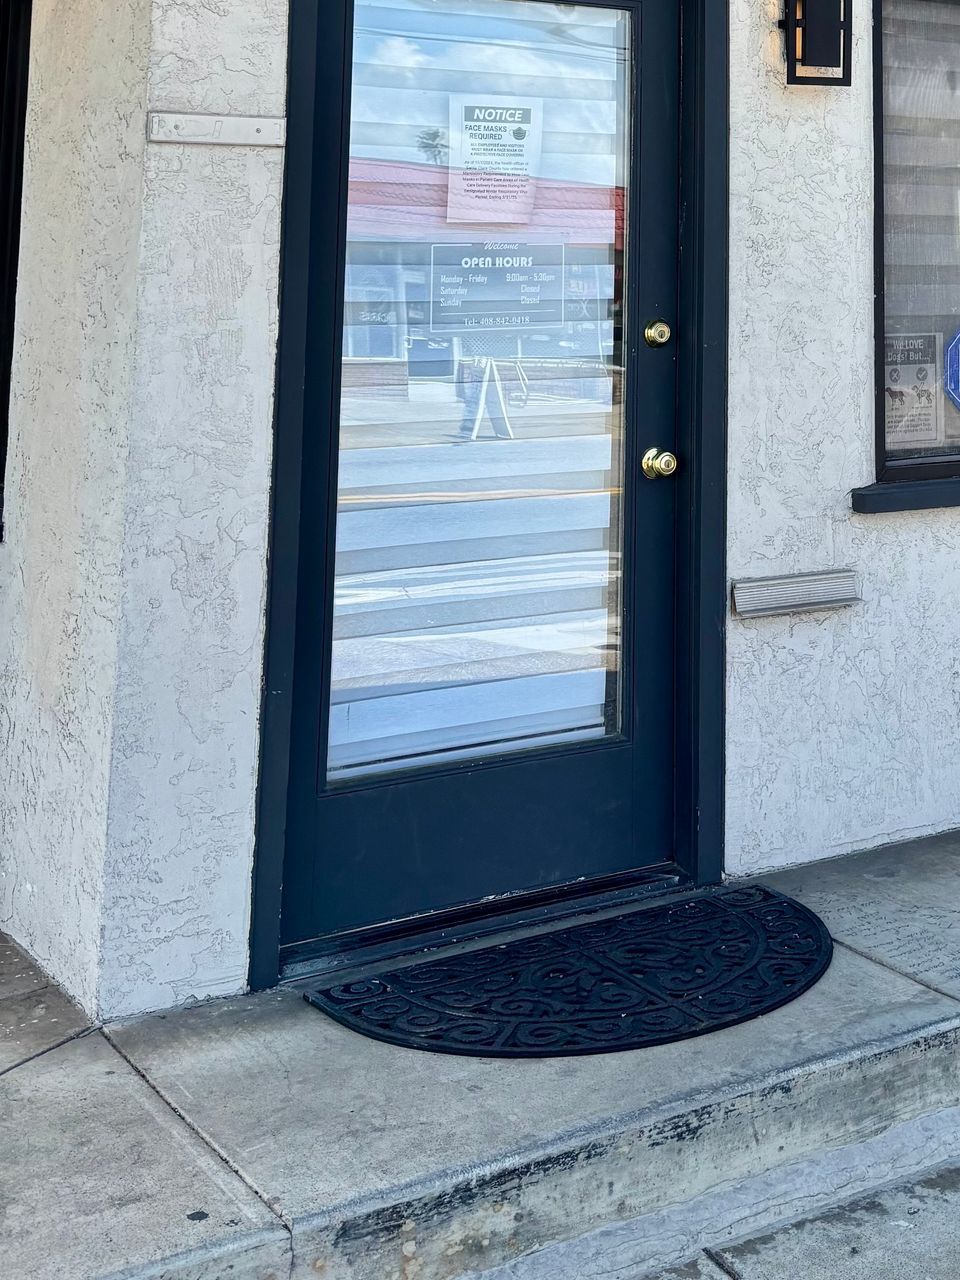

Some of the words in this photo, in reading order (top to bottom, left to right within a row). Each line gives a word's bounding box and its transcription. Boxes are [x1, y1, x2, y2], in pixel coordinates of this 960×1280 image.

[473, 108, 523, 121] NOTICE
[464, 124, 482, 132] FACE
[469, 132, 502, 140] REQUIRED
[483, 240, 520, 250] Welcome
[461, 257, 492, 268] OPEN
[495, 256, 533, 268] HOURS
[440, 274, 463, 284] Monday
[468, 273, 488, 284] Friday
[506, 273, 529, 282] 9:00am
[440, 286, 468, 295] Saturday
[520, 284, 540, 293] Closed
[440, 297, 462, 307] Sunday
[520, 295, 540, 304] Closed
[905, 338, 924, 349] LOVE
